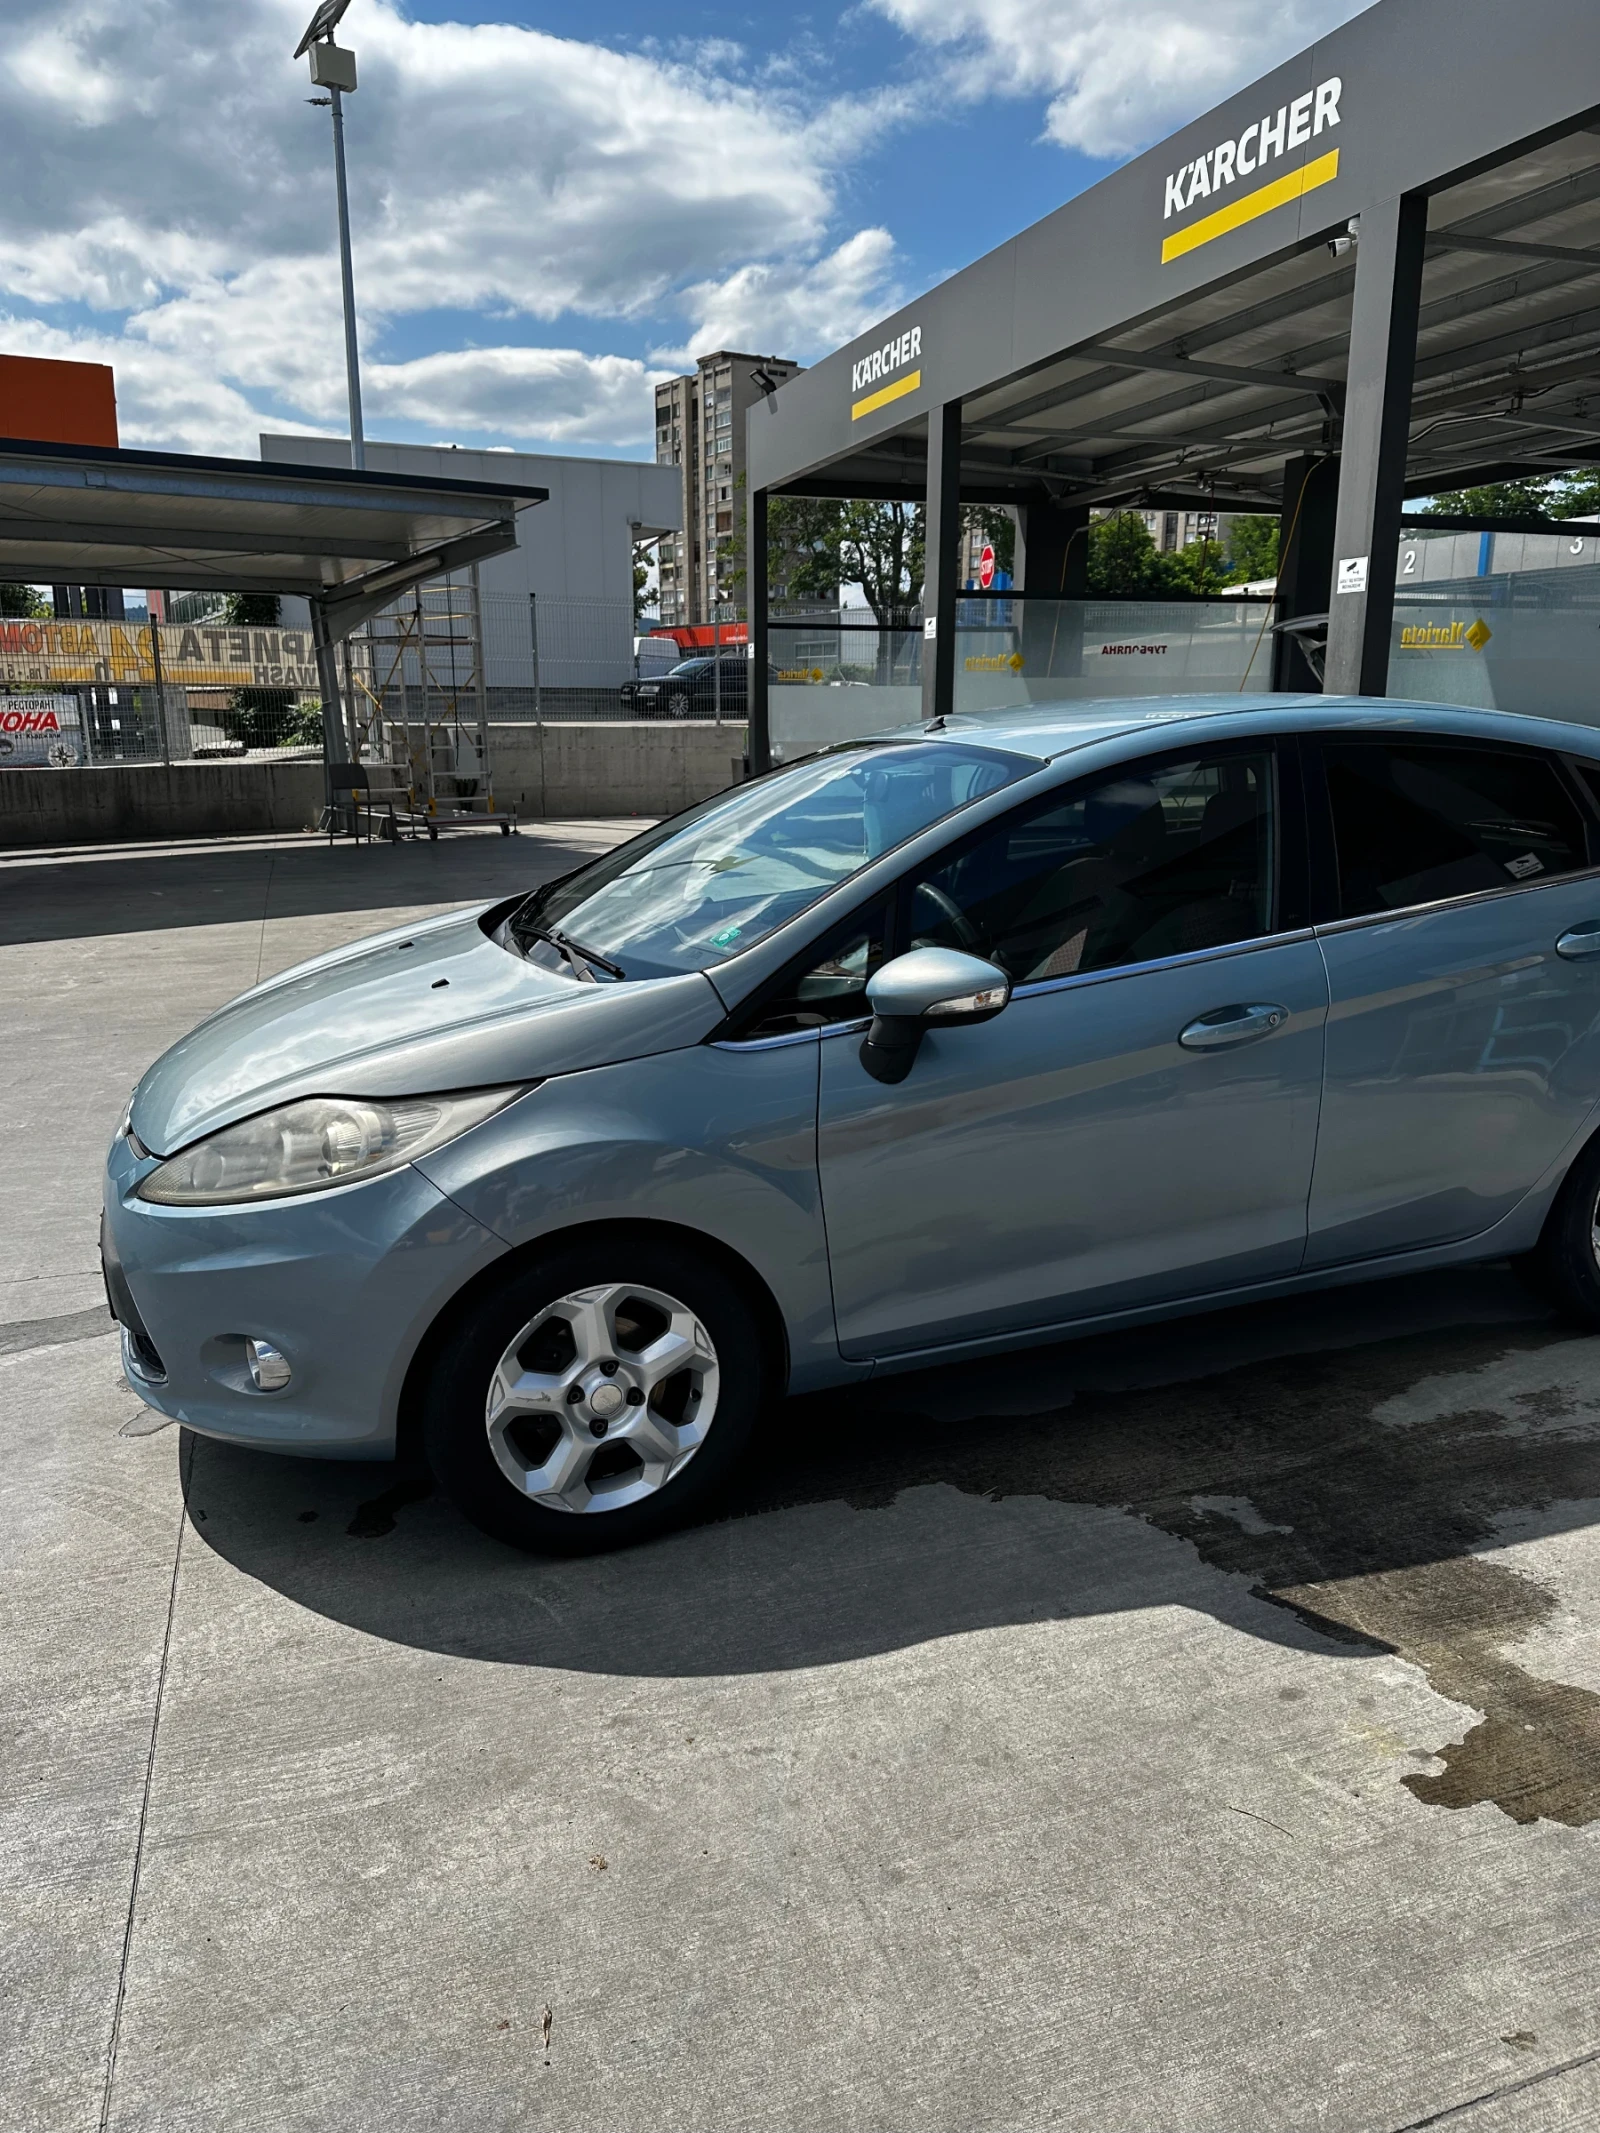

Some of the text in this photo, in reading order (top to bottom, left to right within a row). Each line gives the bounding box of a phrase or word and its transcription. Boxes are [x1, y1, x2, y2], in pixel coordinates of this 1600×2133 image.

[1163, 76, 1343, 220] KÄRCHER
[851, 325, 922, 393] KÄRCHER
[1569, 536, 1584, 555] 3
[981, 558, 993, 576] STOP
[1403, 550, 1416, 575] 2
[8, 699, 55, 710] РЕСТОРАНТ
[0, 711, 59, 732] ОНА
